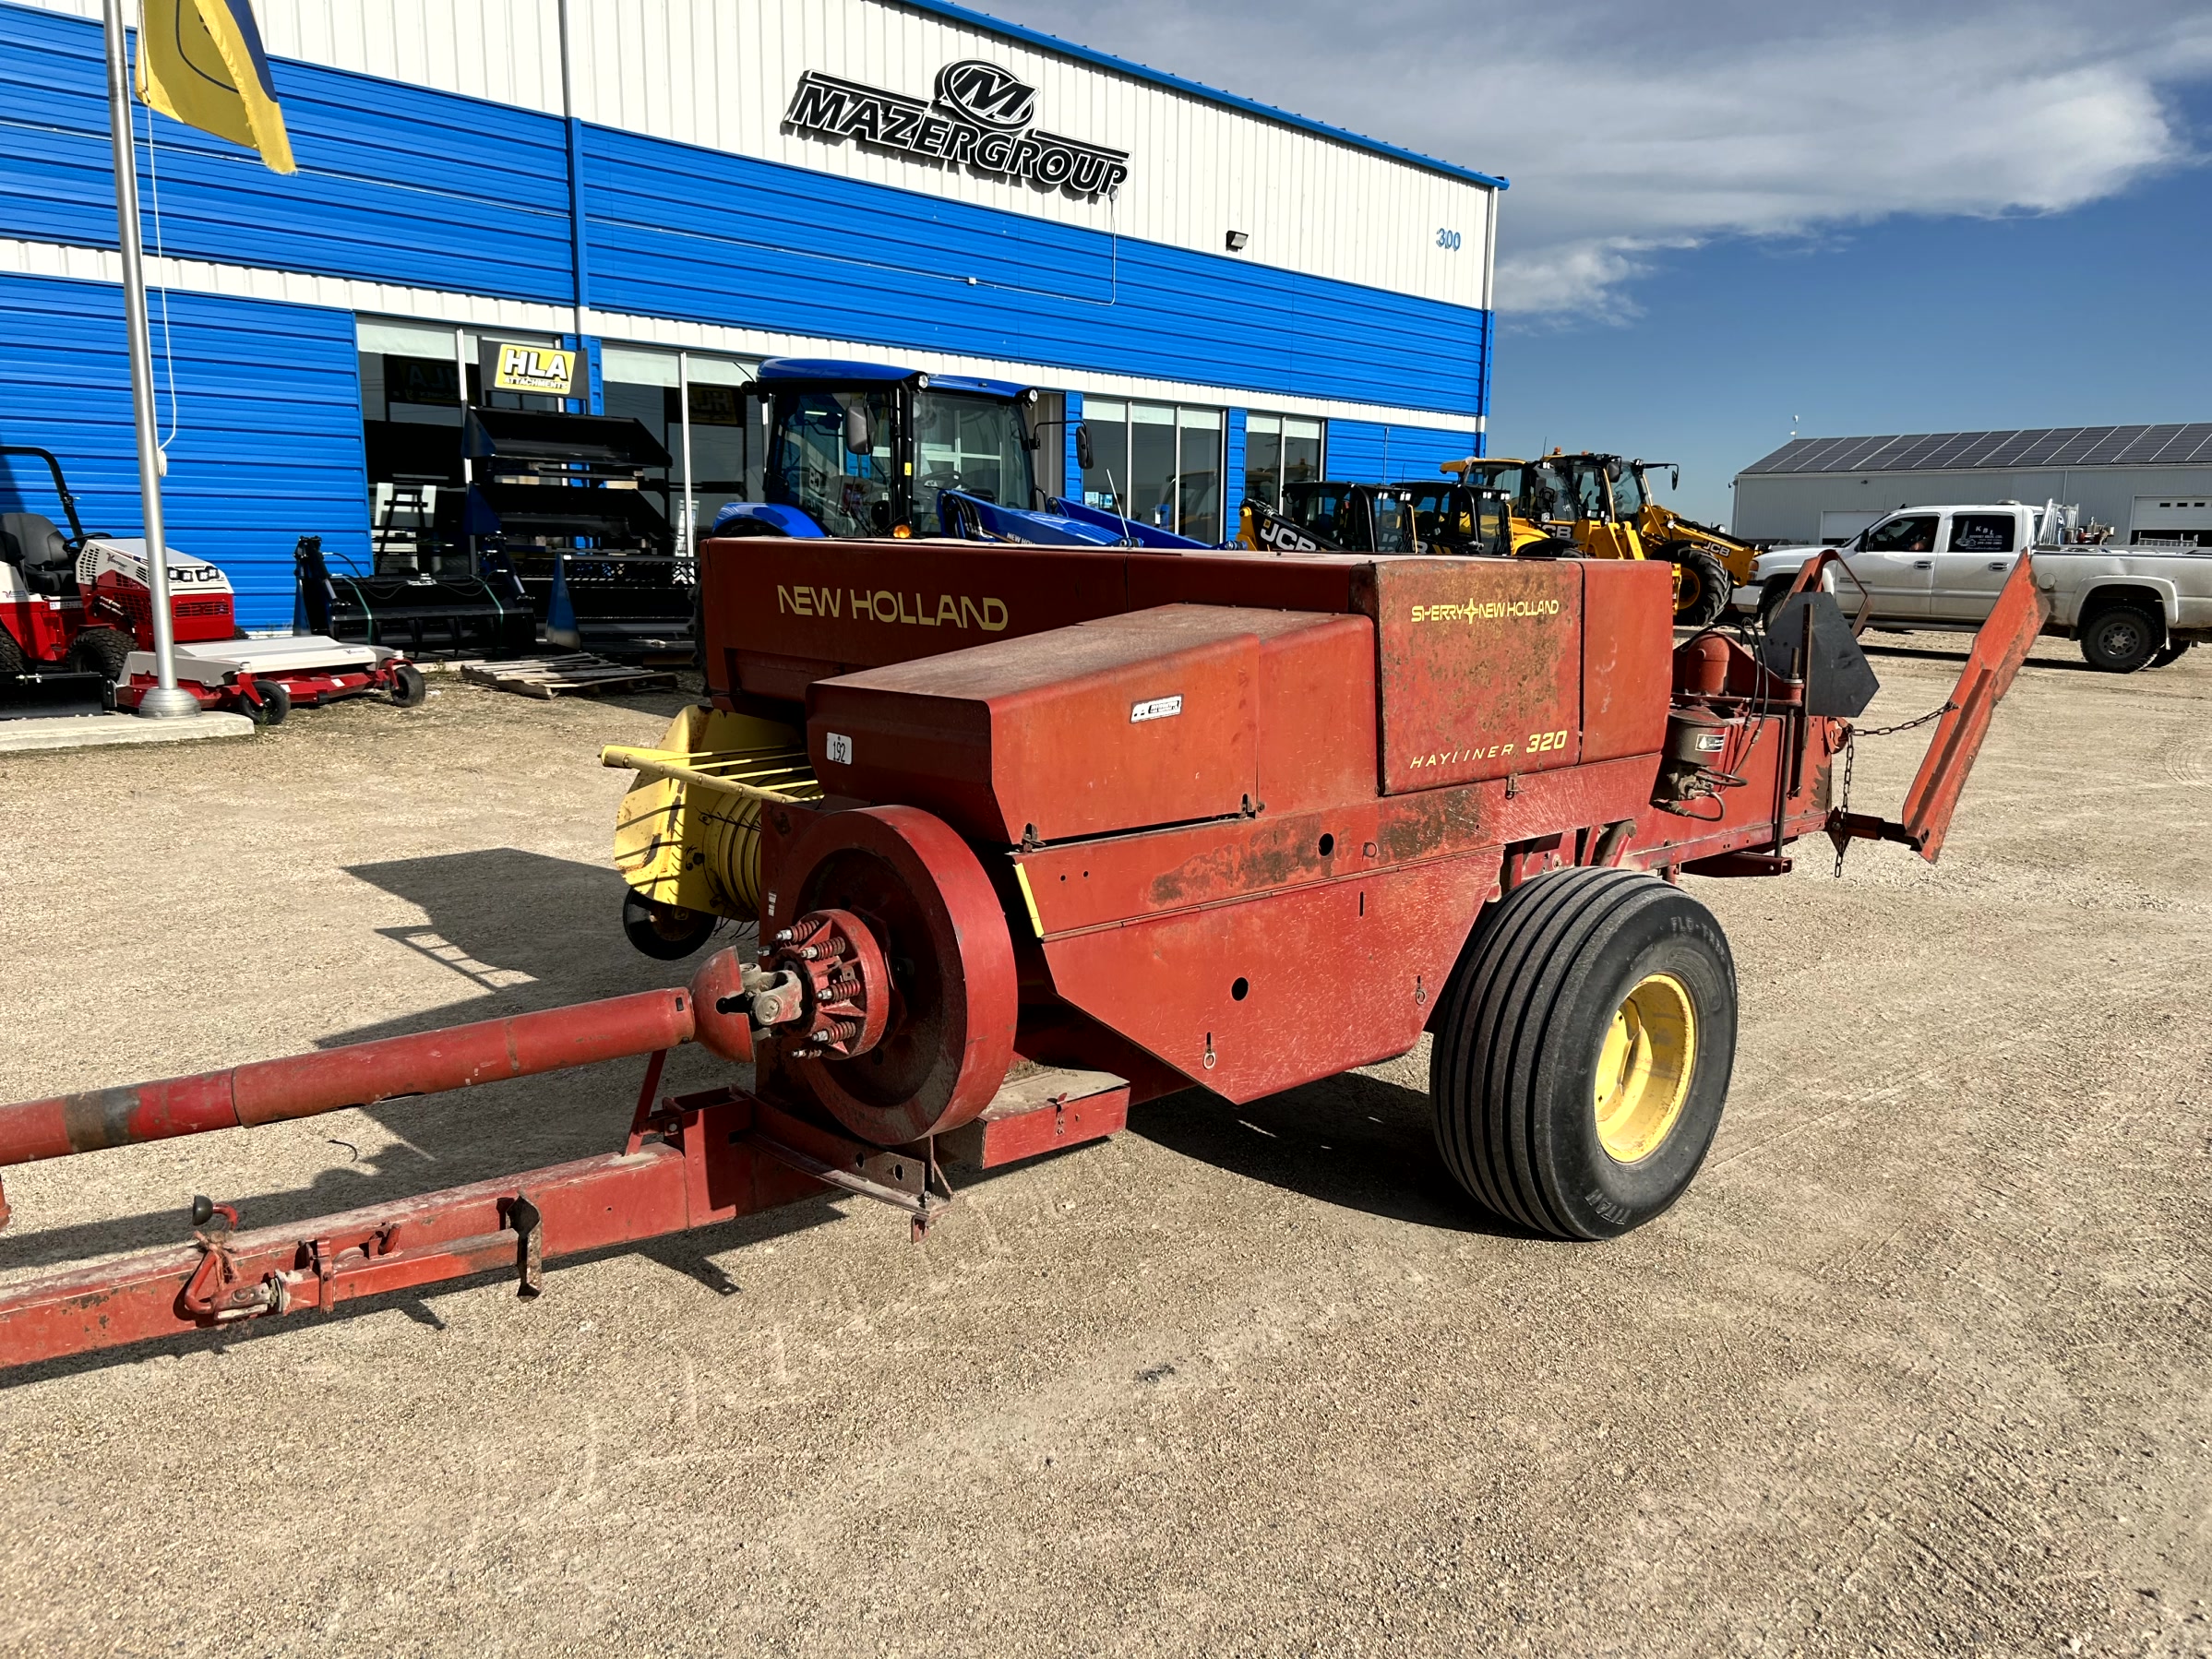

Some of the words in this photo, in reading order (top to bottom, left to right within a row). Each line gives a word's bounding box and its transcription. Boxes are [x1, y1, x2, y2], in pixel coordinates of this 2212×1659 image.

[788, 84, 1129, 197] MAZERGROUP
[1436, 228, 1461, 251] 300
[504, 348, 569, 381] HLA
[503, 376, 568, 389] ATTACHMENTS
[1007, 532, 1022, 543] NEW
[1703, 542, 1730, 557] JCB
[777, 585, 842, 617] NEW
[850, 589, 1009, 631] HOLLAND
[1478, 603, 1505, 618] NEW
[1507, 600, 1560, 616] HOLLAND
[832, 741, 846, 763] 192
[1409, 744, 1514, 769] HAYLINER
[1525, 730, 1568, 753] 320
